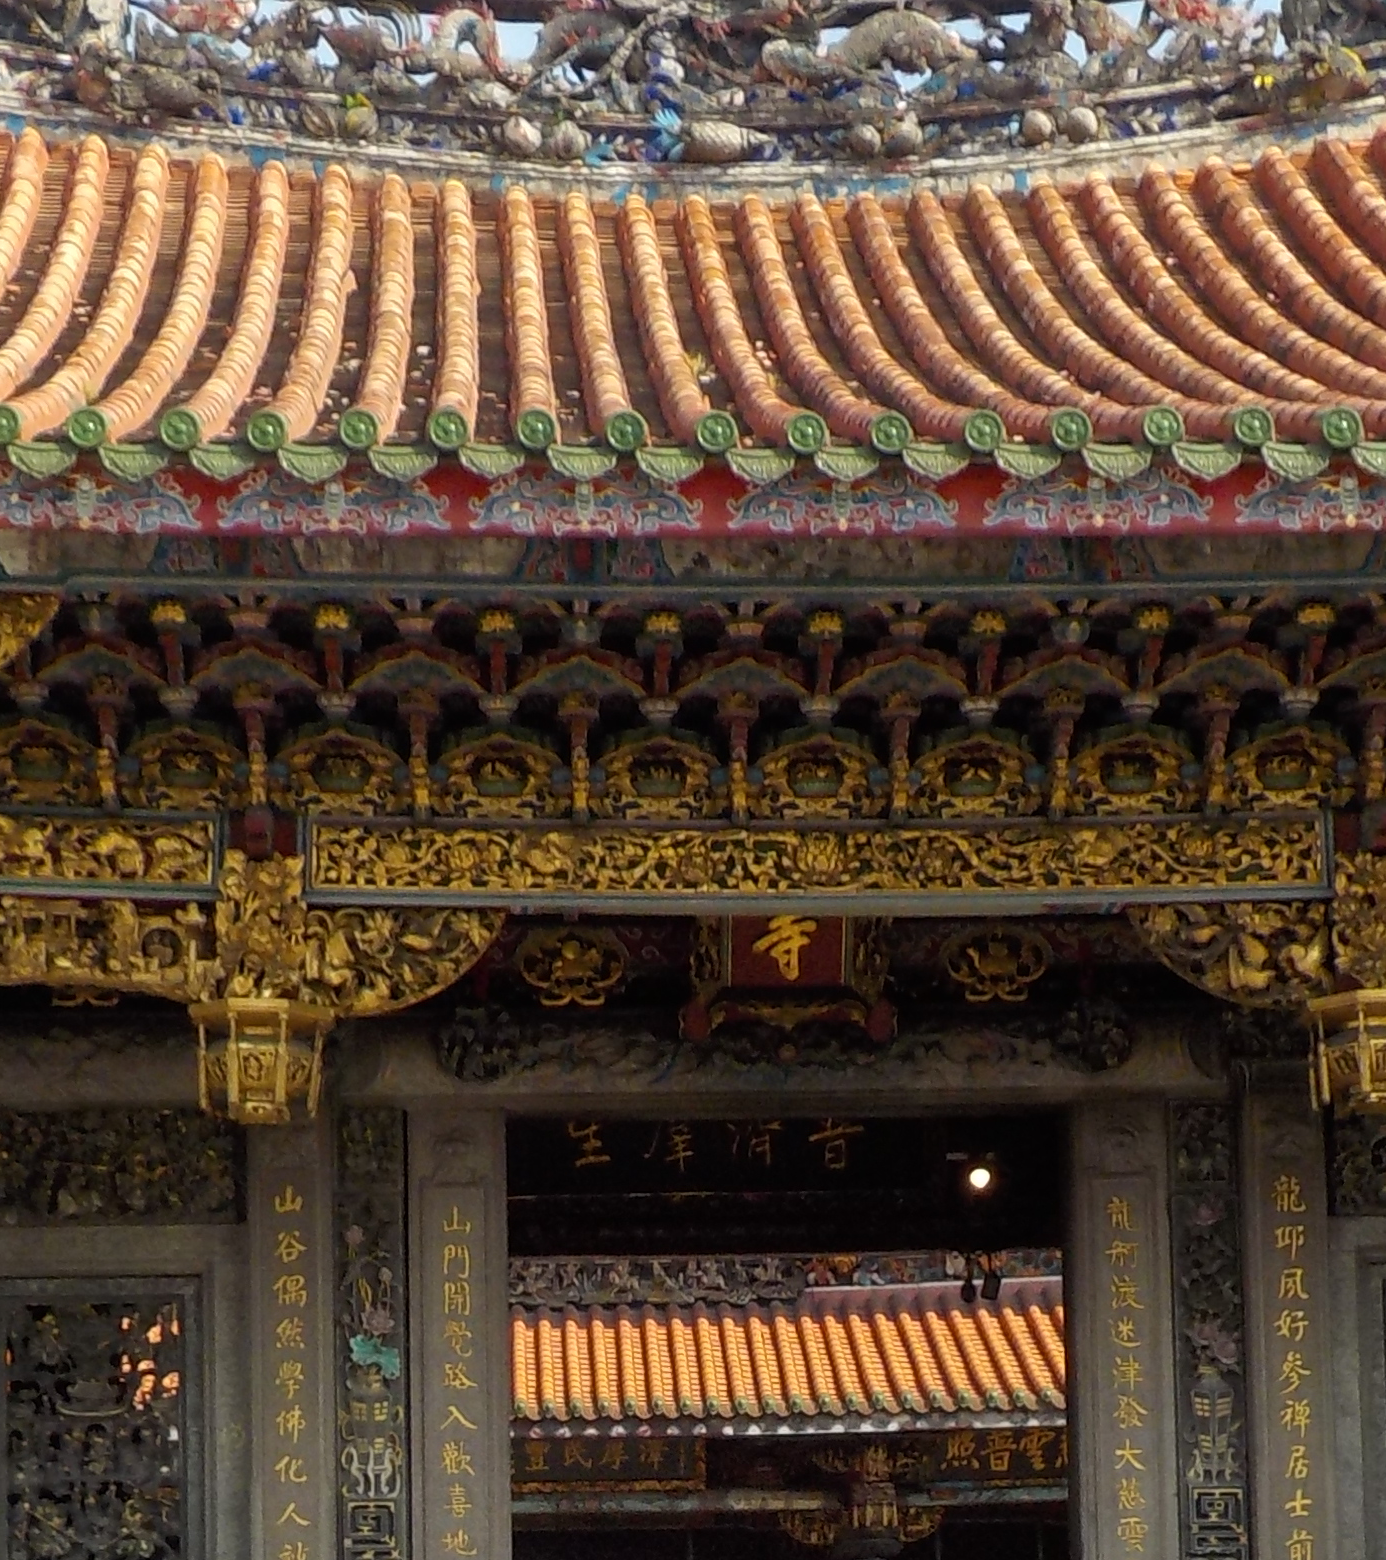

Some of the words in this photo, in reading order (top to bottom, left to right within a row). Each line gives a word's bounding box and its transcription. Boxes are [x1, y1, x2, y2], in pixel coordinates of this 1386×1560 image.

[752, 914, 817, 981] 寺
[940, 1429, 1069, 1472] 雲普照
